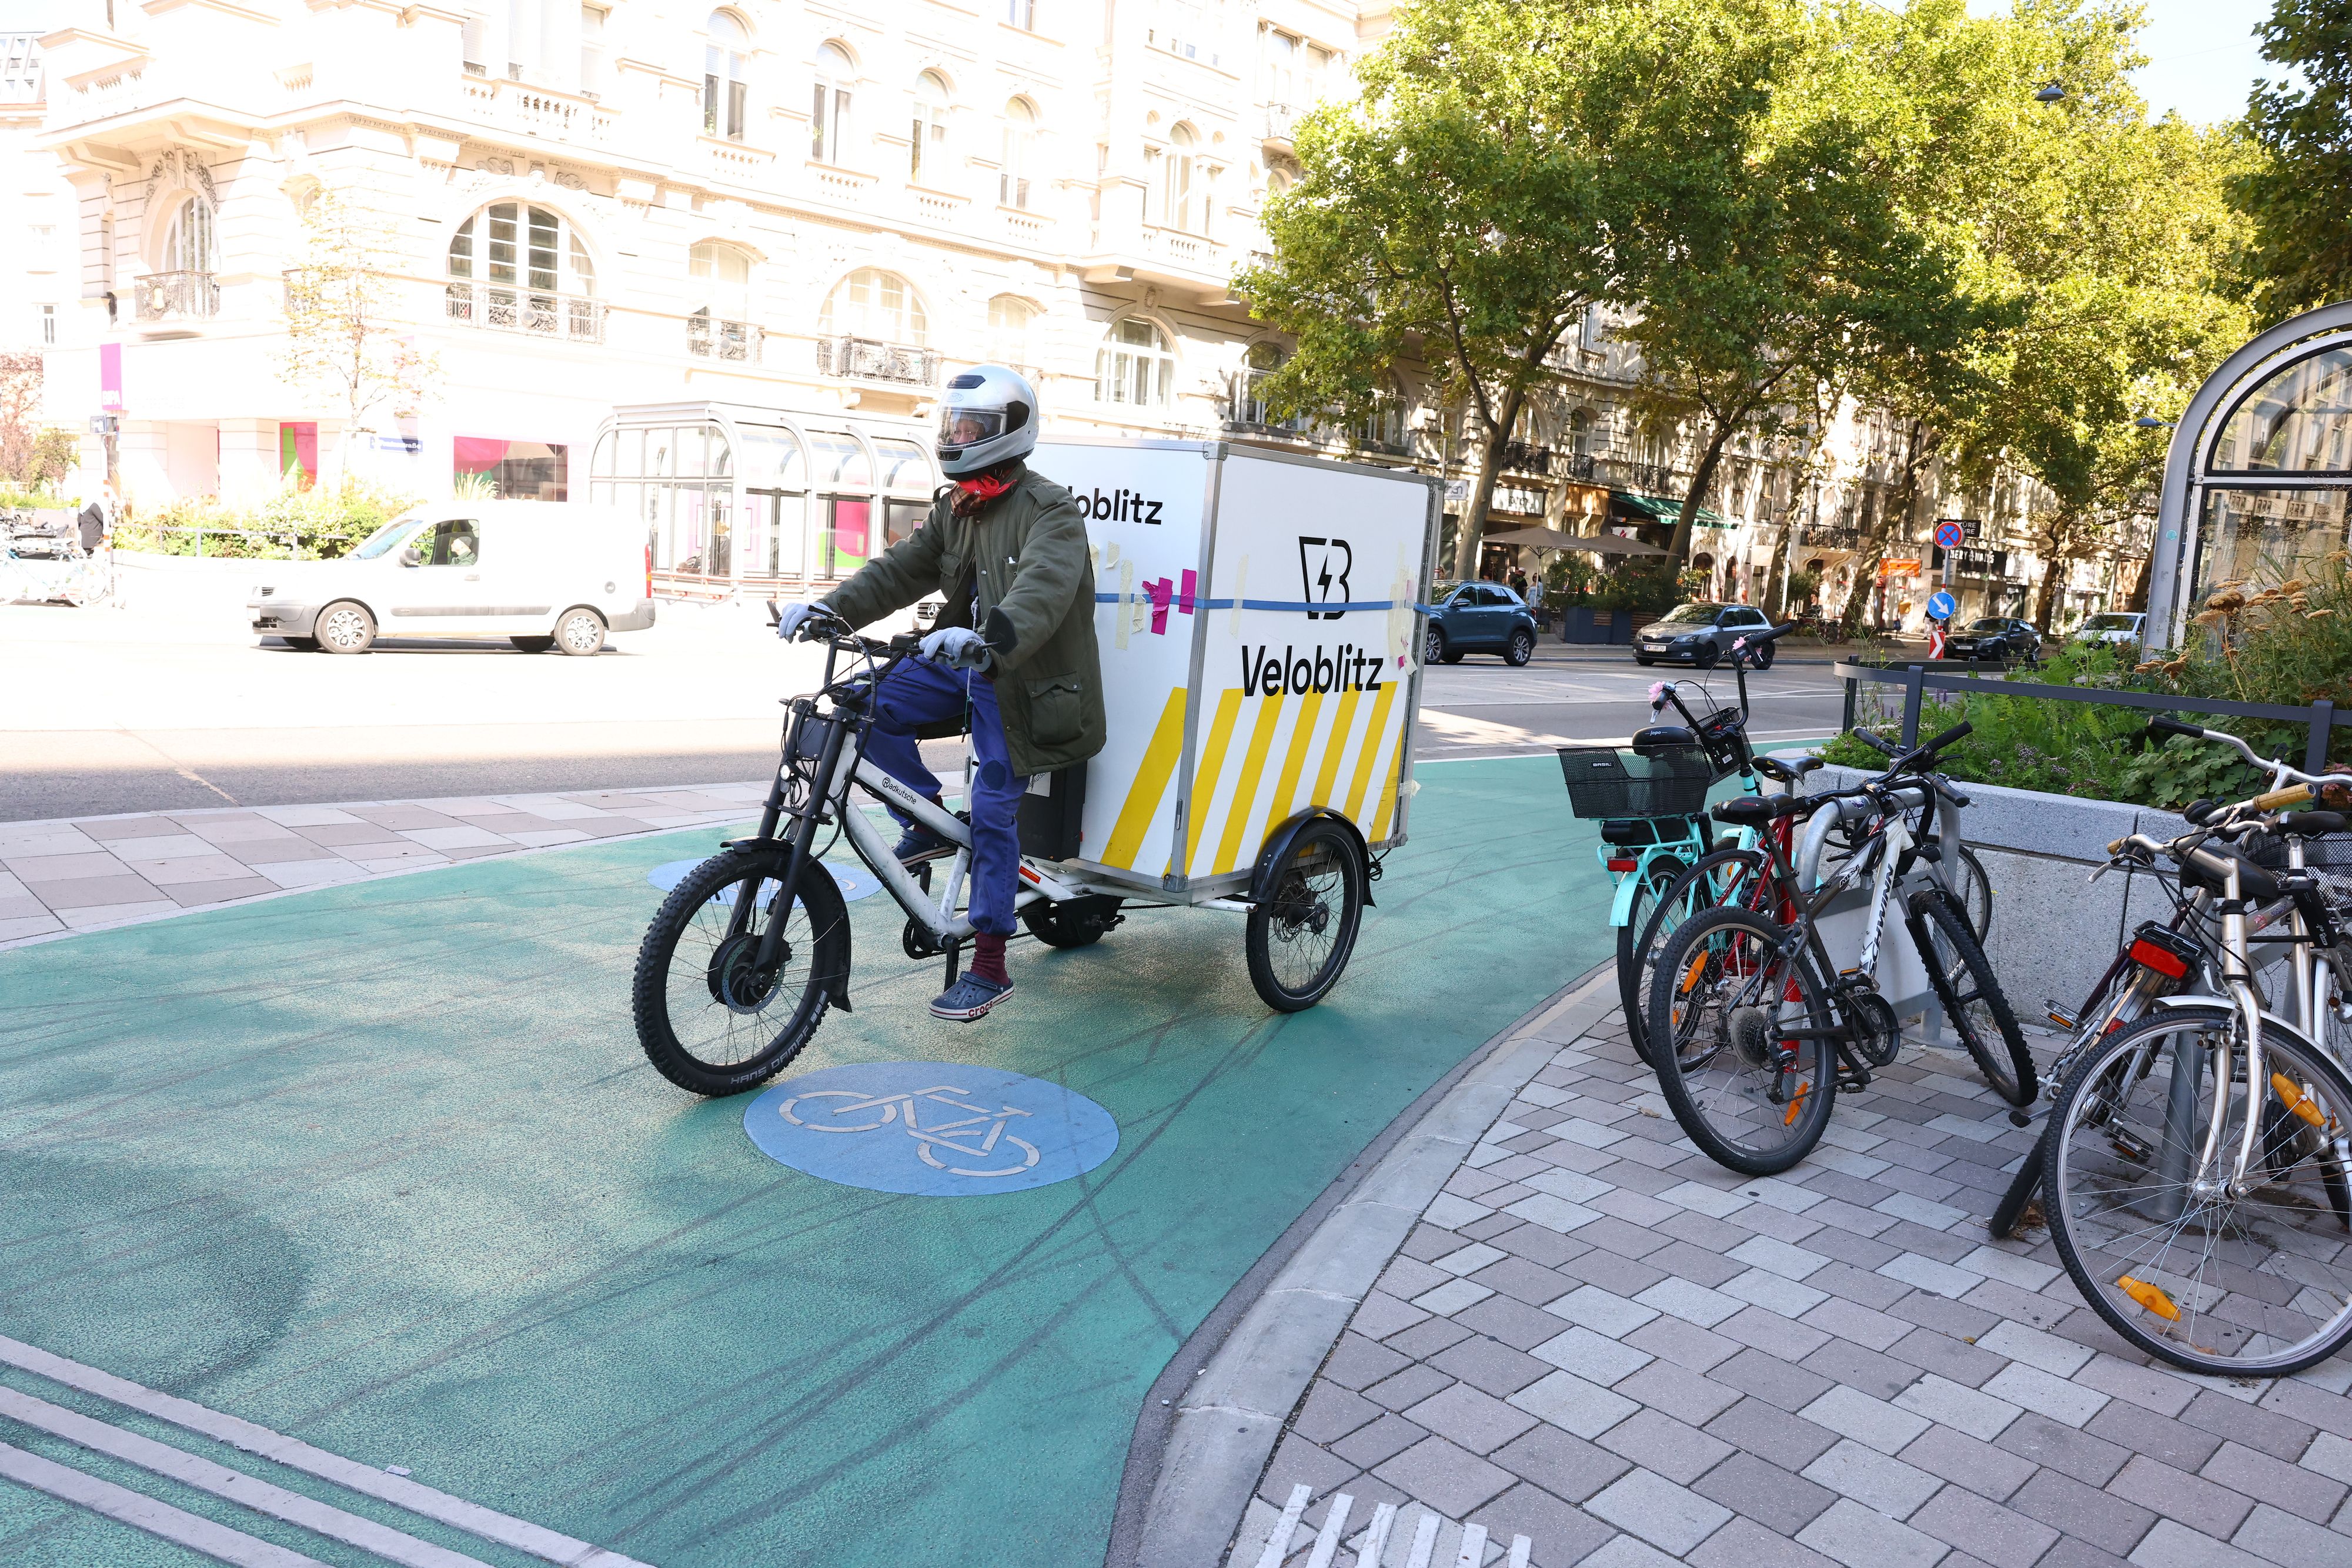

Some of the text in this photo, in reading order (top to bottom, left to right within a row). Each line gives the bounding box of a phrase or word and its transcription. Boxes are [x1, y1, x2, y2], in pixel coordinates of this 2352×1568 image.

[103, 390, 121, 405] BIPA
[1950, 550, 1968, 560] MERY
[1242, 643, 1384, 697] Veloblitz
[882, 777, 917, 805] Radkutsche
[1840, 864, 1860, 887] MESA
[1749, 897, 1757, 909] SIMP
[1869, 863, 1893, 978] SCHWINN
[968, 1001, 993, 1017] crocs
[730, 1025, 810, 1085] HANS DAMPF
